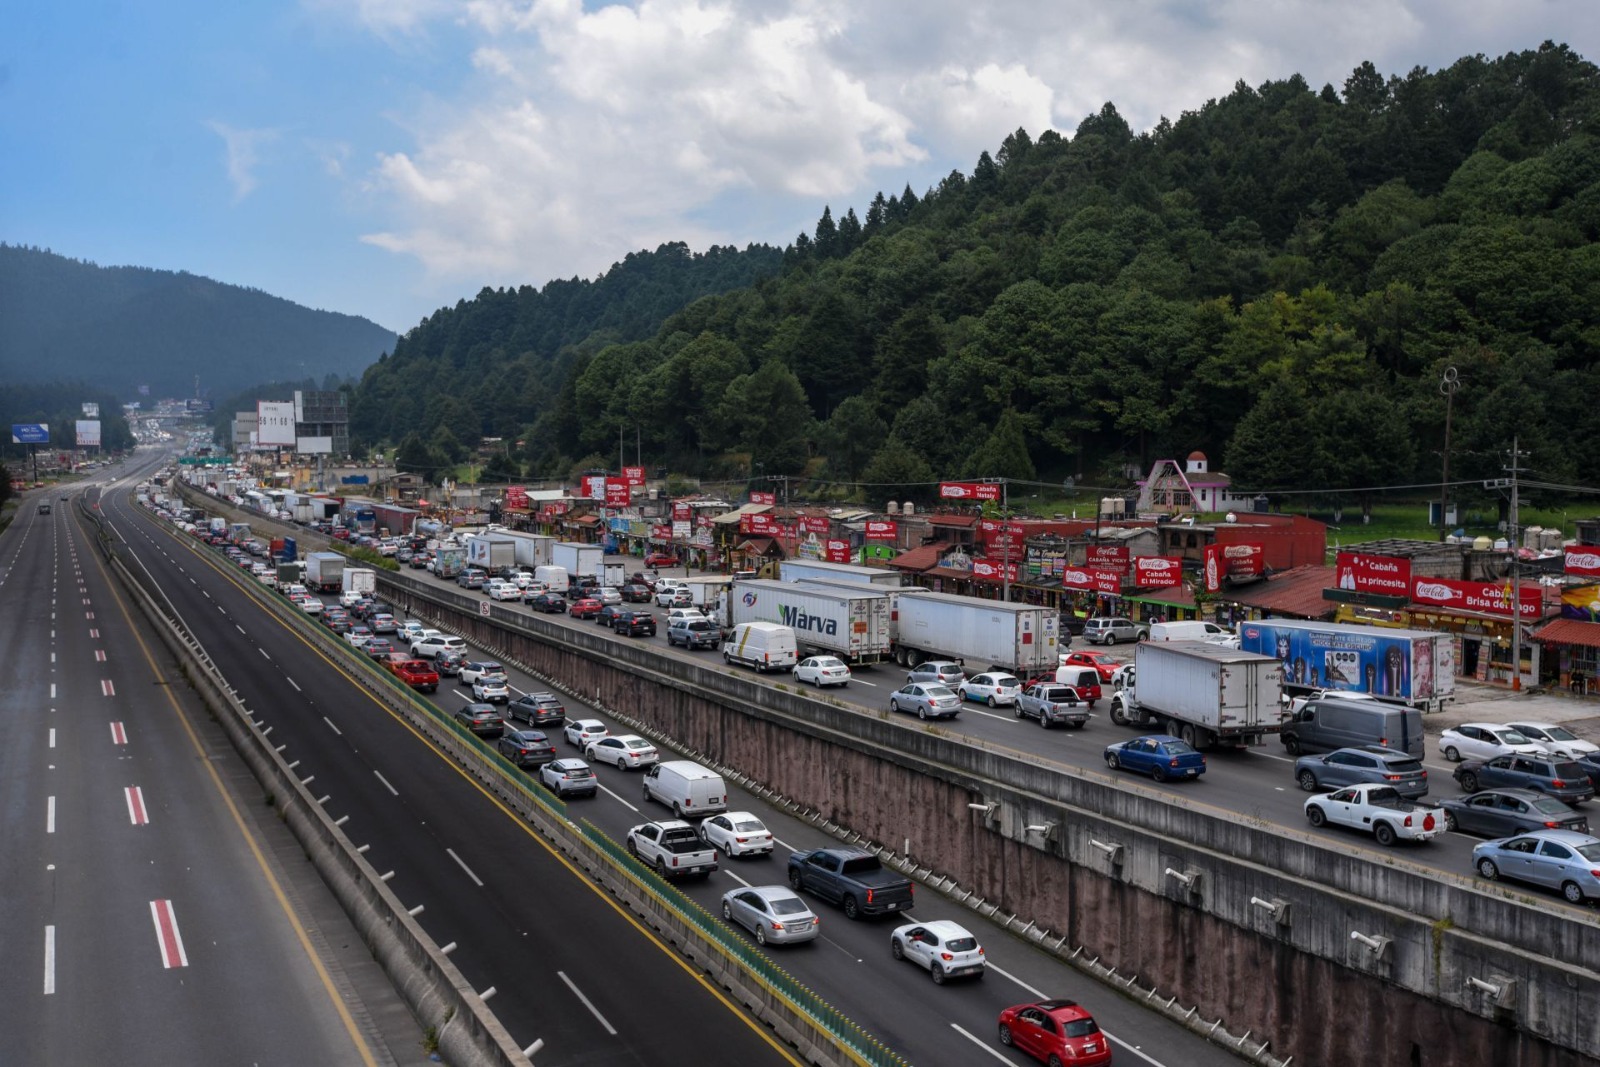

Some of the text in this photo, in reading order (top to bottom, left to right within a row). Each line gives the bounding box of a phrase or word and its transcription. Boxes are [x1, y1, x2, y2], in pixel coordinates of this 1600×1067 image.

[975, 485, 997, 493] Cabaña
[997, 563, 1016, 572] Caaña
[1369, 561, 1399, 573] Cabaña
[1095, 571, 1117, 581] Cabaña
[1098, 581, 1114, 591] Vicky
[1357, 575, 1406, 589] La princesita
[1466, 596, 1491, 608] Brisa
[782, 605, 837, 636] Marva
